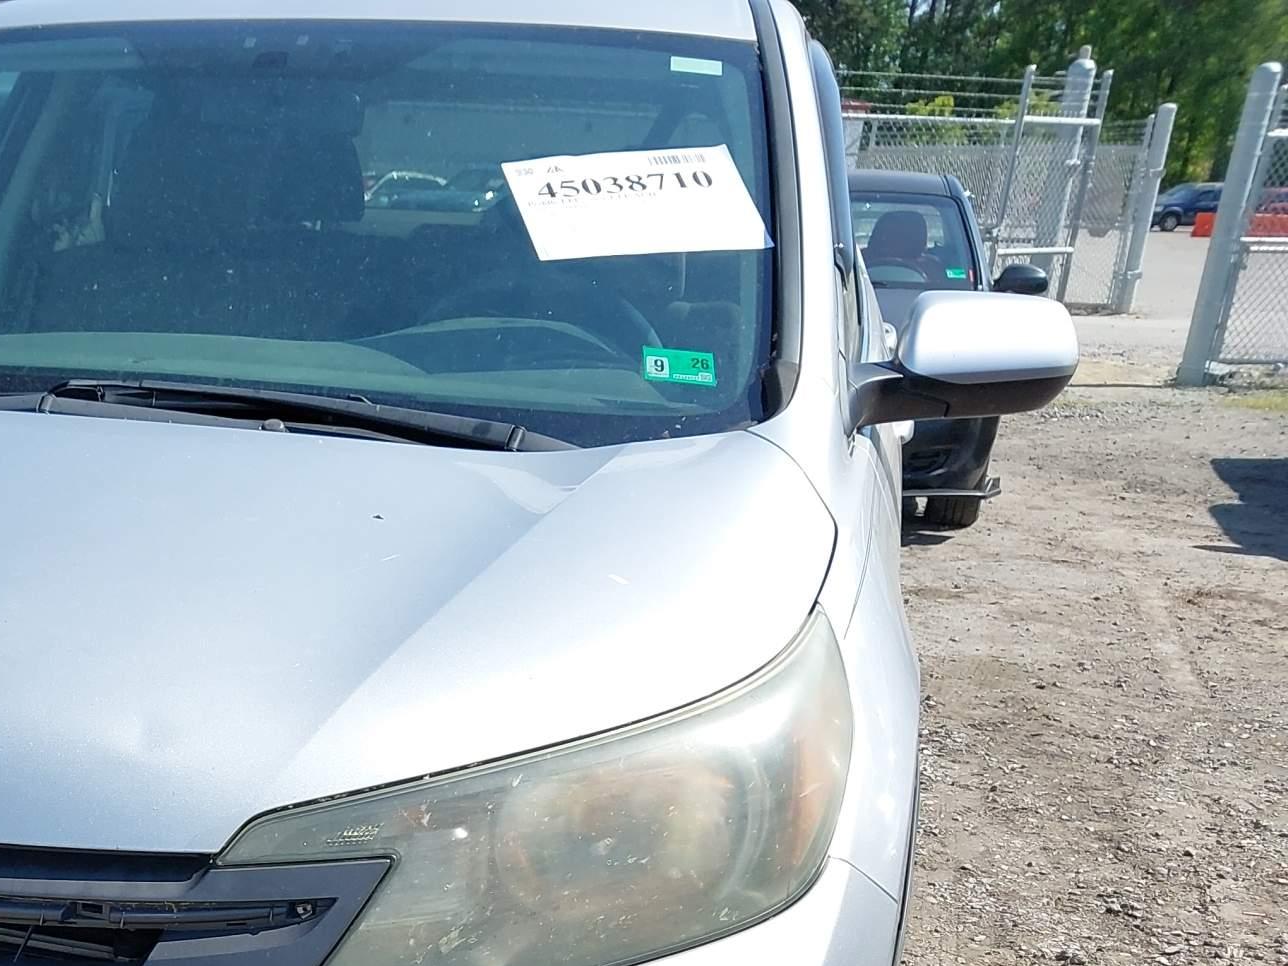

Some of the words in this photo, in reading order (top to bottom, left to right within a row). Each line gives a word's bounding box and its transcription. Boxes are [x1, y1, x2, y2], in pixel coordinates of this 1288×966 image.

[537, 170, 713, 198] 45038710
[653, 358, 665, 373] 9
[691, 357, 710, 370] 26
